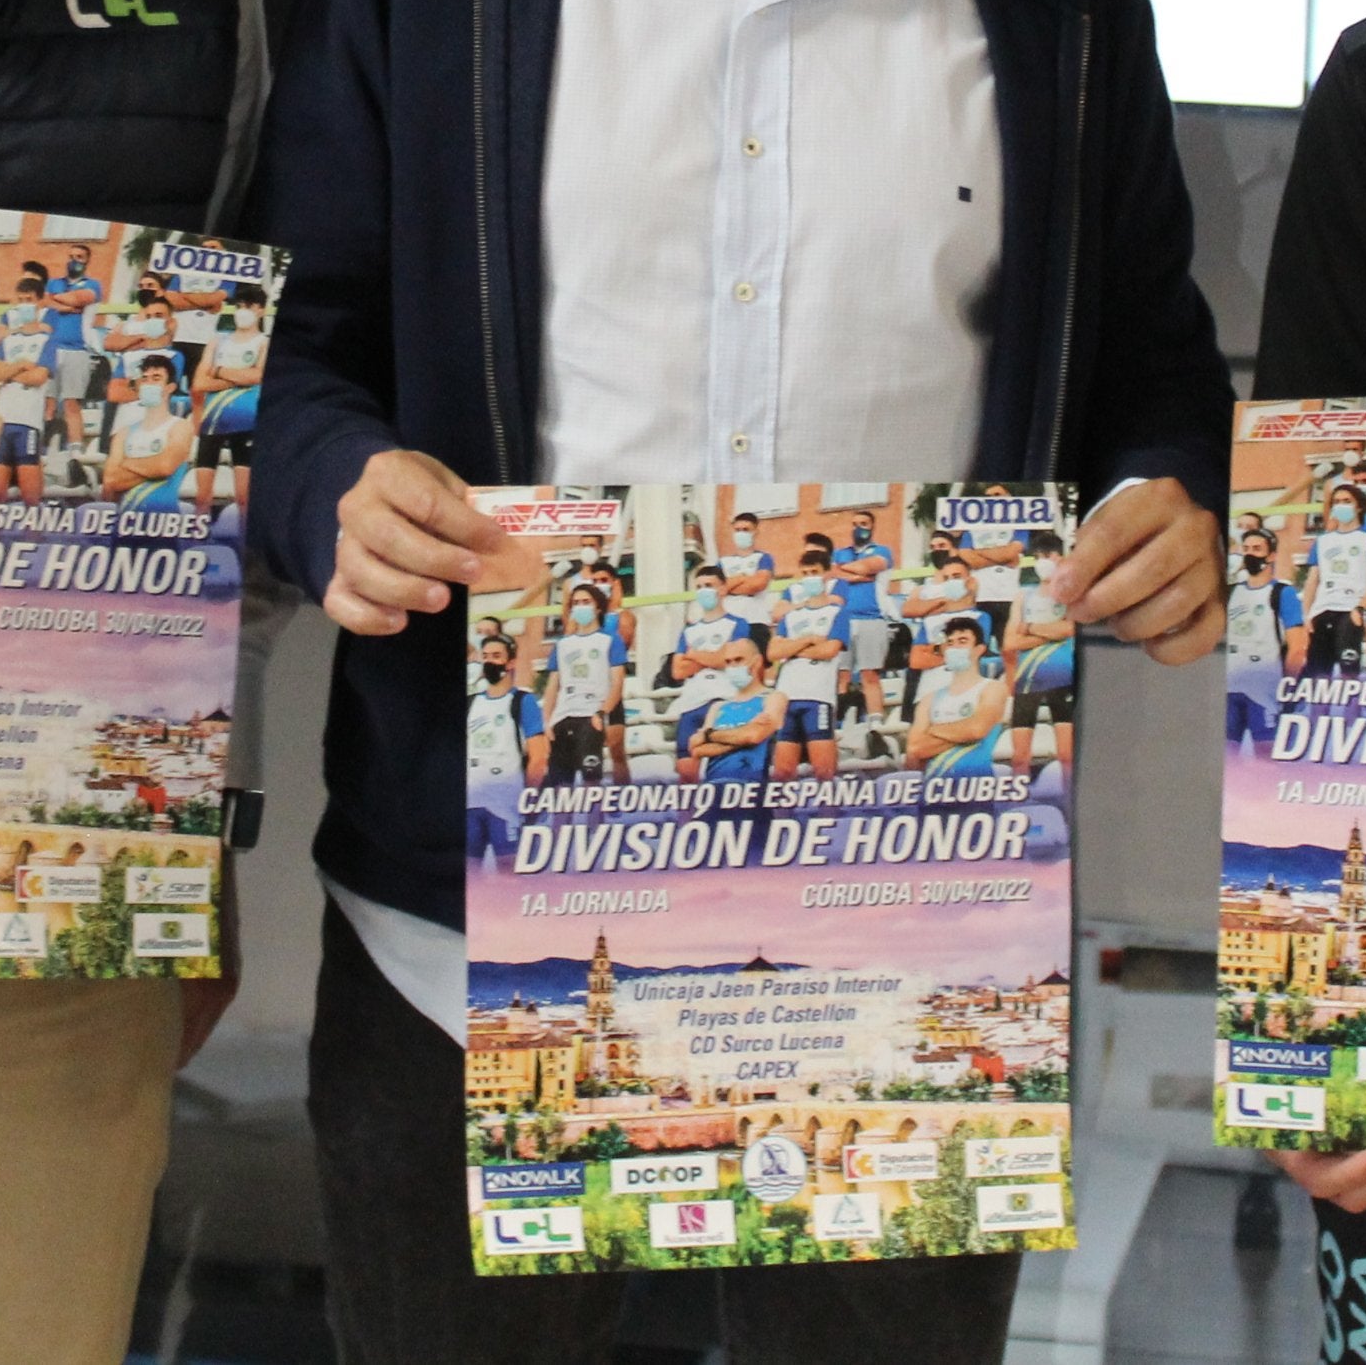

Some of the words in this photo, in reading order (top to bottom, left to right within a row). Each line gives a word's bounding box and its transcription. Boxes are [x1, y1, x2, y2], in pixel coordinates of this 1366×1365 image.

[154, 244, 264, 278] Joma
[80, 509, 117, 535] DE
[118, 510, 211, 539] CLUBES
[940, 498, 1055, 529] Joma
[39, 544, 208, 596] HONOR
[105, 611, 205, 637] 30/04/2022
[18, 699, 82, 717] Interior
[517, 783, 716, 815] CAMPEONATO
[719, 782, 761, 809] DE
[763, 774, 876, 808] ESPAÑA
[883, 778, 923, 805] DE
[924, 775, 1030, 804] CLUBES
[1277, 781, 1304, 803] 1A
[513, 811, 754, 874] DIVISIÓN
[761, 818, 835, 866] DE
[841, 811, 1030, 864] HONOR
[521, 893, 549, 916] 1A
[555, 889, 669, 915] JORNADA
[801, 880, 912, 907] CÓRDOBA
[918, 878, 1031, 905] 30/04/2022
[634, 981, 704, 1003] Unicaja
[710, 981, 754, 998] Jaen
[760, 978, 828, 996] Paraiso
[834, 975, 902, 994] Interior
[678, 1009, 738, 1030] Playas
[744, 1008, 766, 1024] de
[690, 1036, 716, 1054] CD
[720, 1035, 773, 1053] Surco
[779, 1034, 845, 1051] Lucena
[736, 1060, 799, 1080] CAPEX
